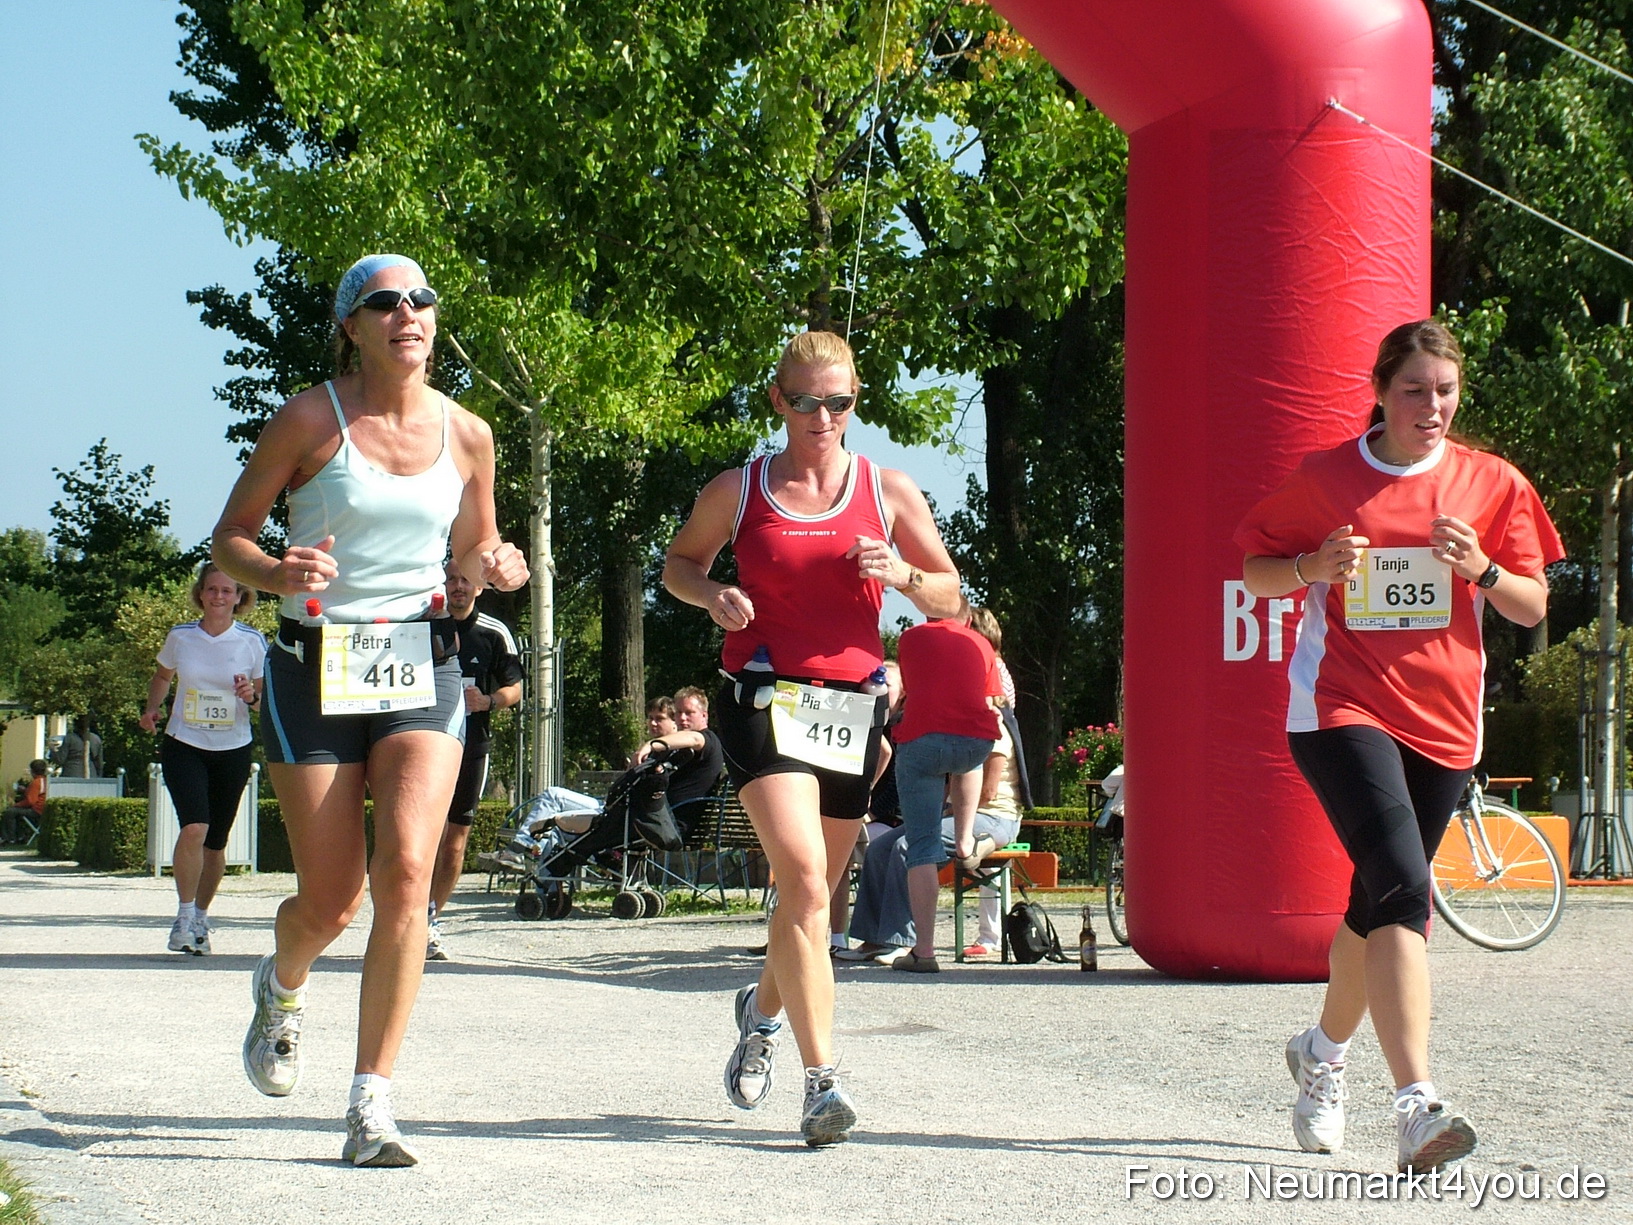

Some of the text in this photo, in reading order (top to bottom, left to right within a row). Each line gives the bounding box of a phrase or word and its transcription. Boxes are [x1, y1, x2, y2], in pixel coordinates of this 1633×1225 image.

[1374, 555, 1409, 573] Tanja
[1350, 580, 1356, 591] D
[1385, 583, 1435, 605] 635
[1223, 580, 1304, 661] Br
[1410, 615, 1449, 624] PFLEIDERER
[352, 632, 391, 649] Petra
[363, 662, 415, 688] 418
[801, 692, 821, 710] Pia
[204, 707, 228, 718] 133
[806, 722, 852, 748] 419
